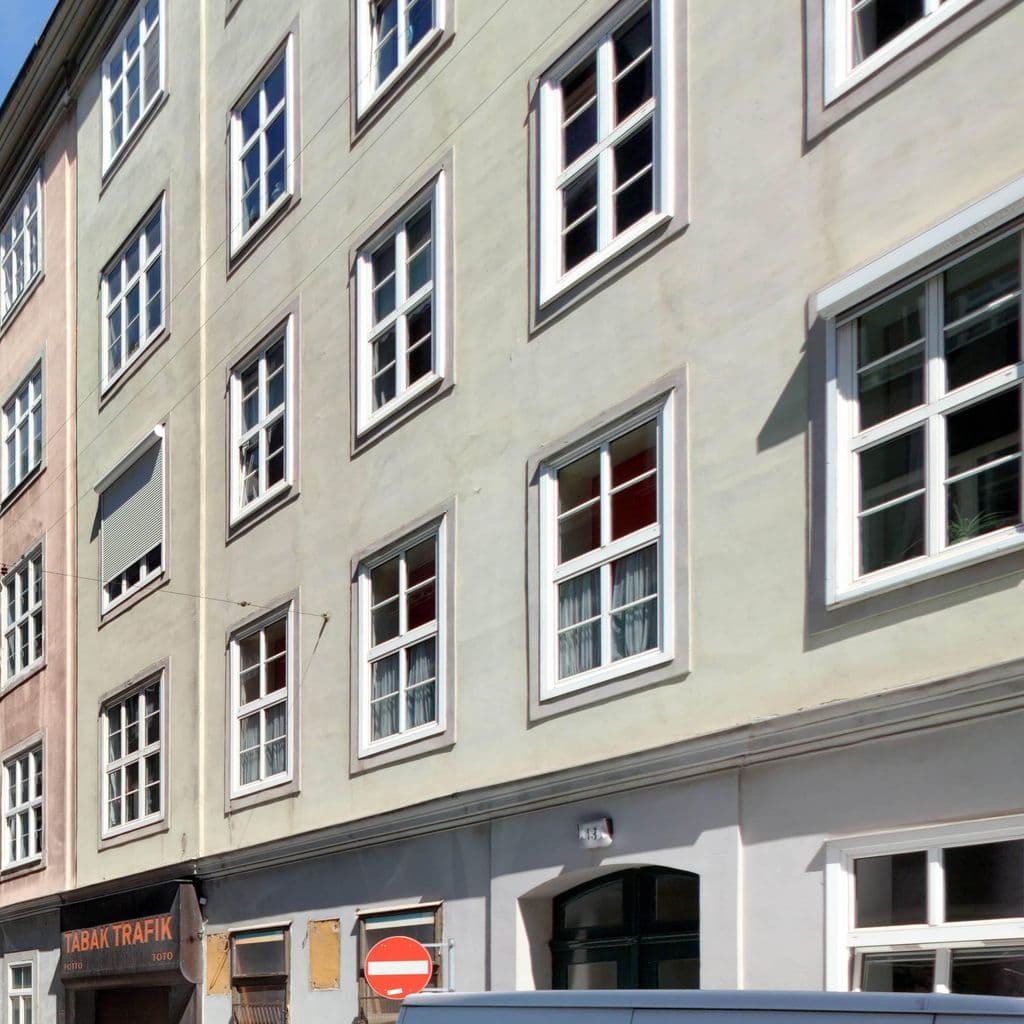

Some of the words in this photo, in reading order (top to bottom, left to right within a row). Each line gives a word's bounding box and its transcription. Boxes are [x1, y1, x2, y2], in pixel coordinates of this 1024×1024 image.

[64, 927, 109, 953] TABAK
[112, 916, 173, 947] TRAFIK
[151, 952, 174, 961] TOTO
